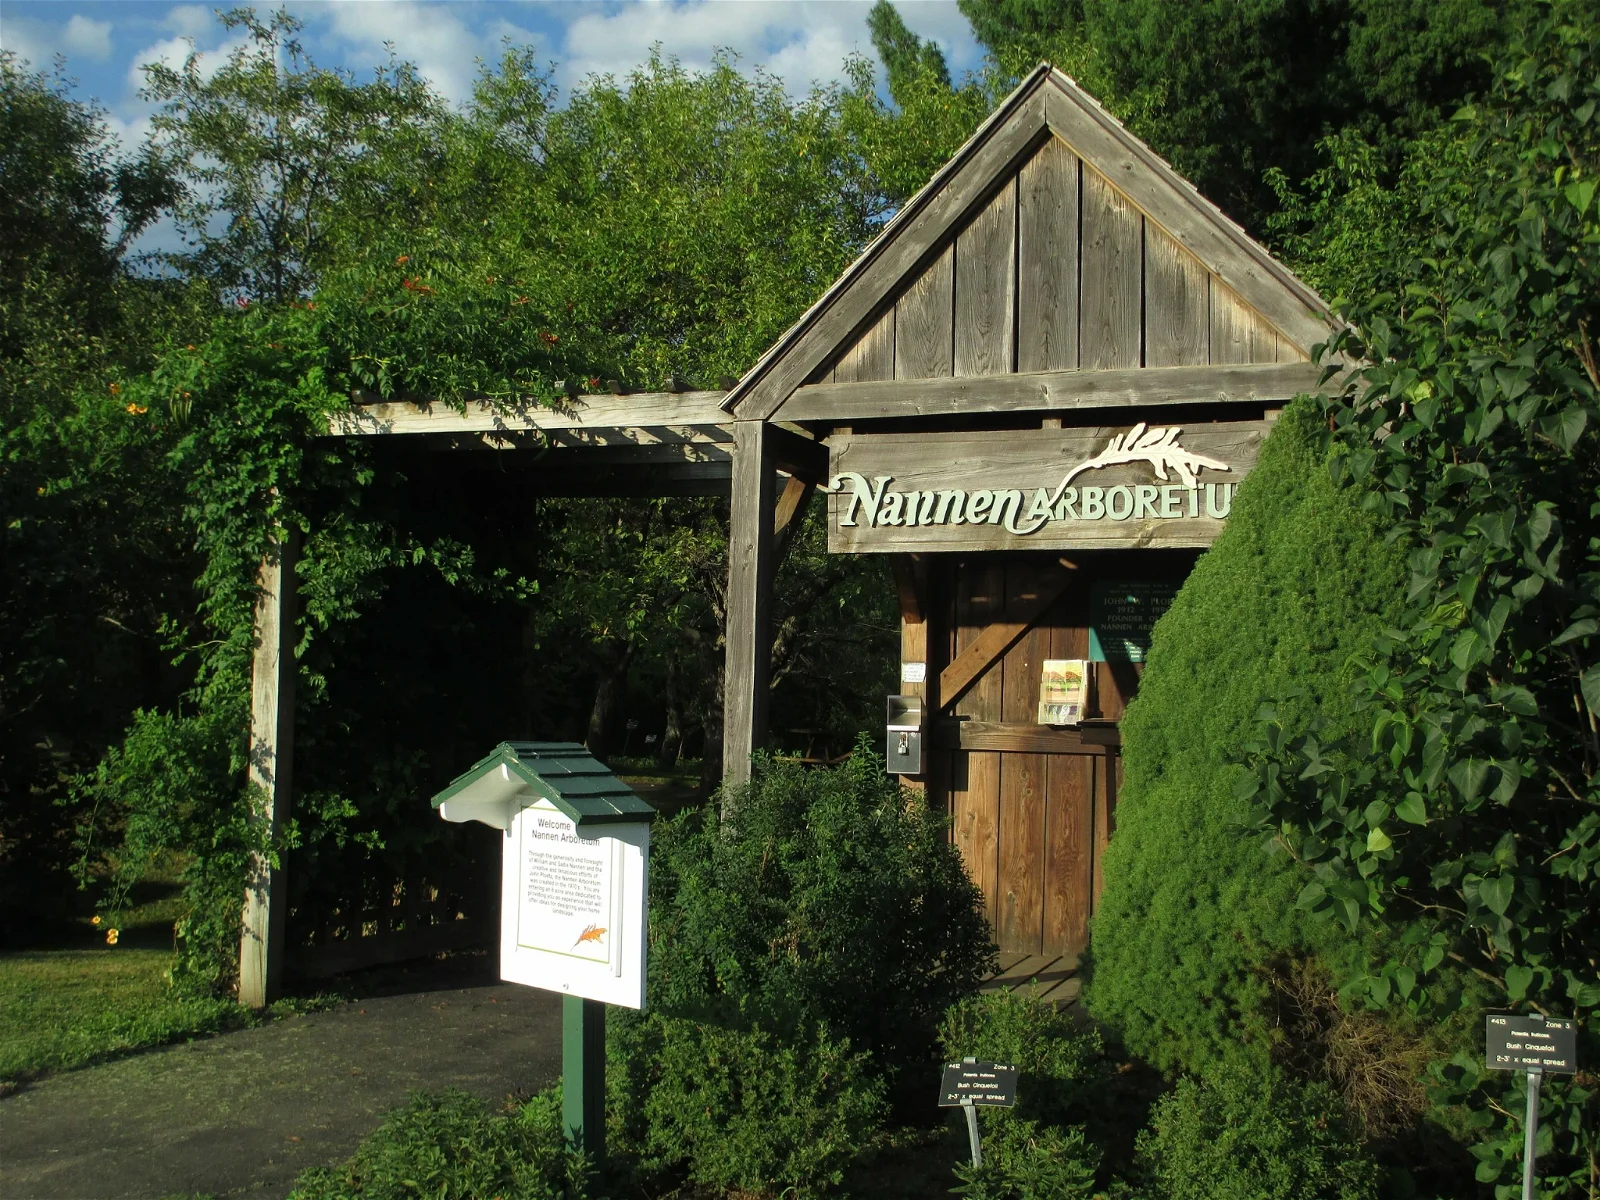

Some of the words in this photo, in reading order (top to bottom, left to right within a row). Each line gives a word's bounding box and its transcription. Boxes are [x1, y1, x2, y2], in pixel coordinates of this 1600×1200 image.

[831, 472, 1046, 535] Nannen
[1026, 481, 1235, 520] ARBORETU
[1104, 597, 1127, 605] JOHN
[538, 818, 571, 831] Welcome
[532, 829, 559, 841] Nannen
[561, 832, 600, 846] Arboretum
[1524, 1043, 1555, 1052] Cinquefoil
